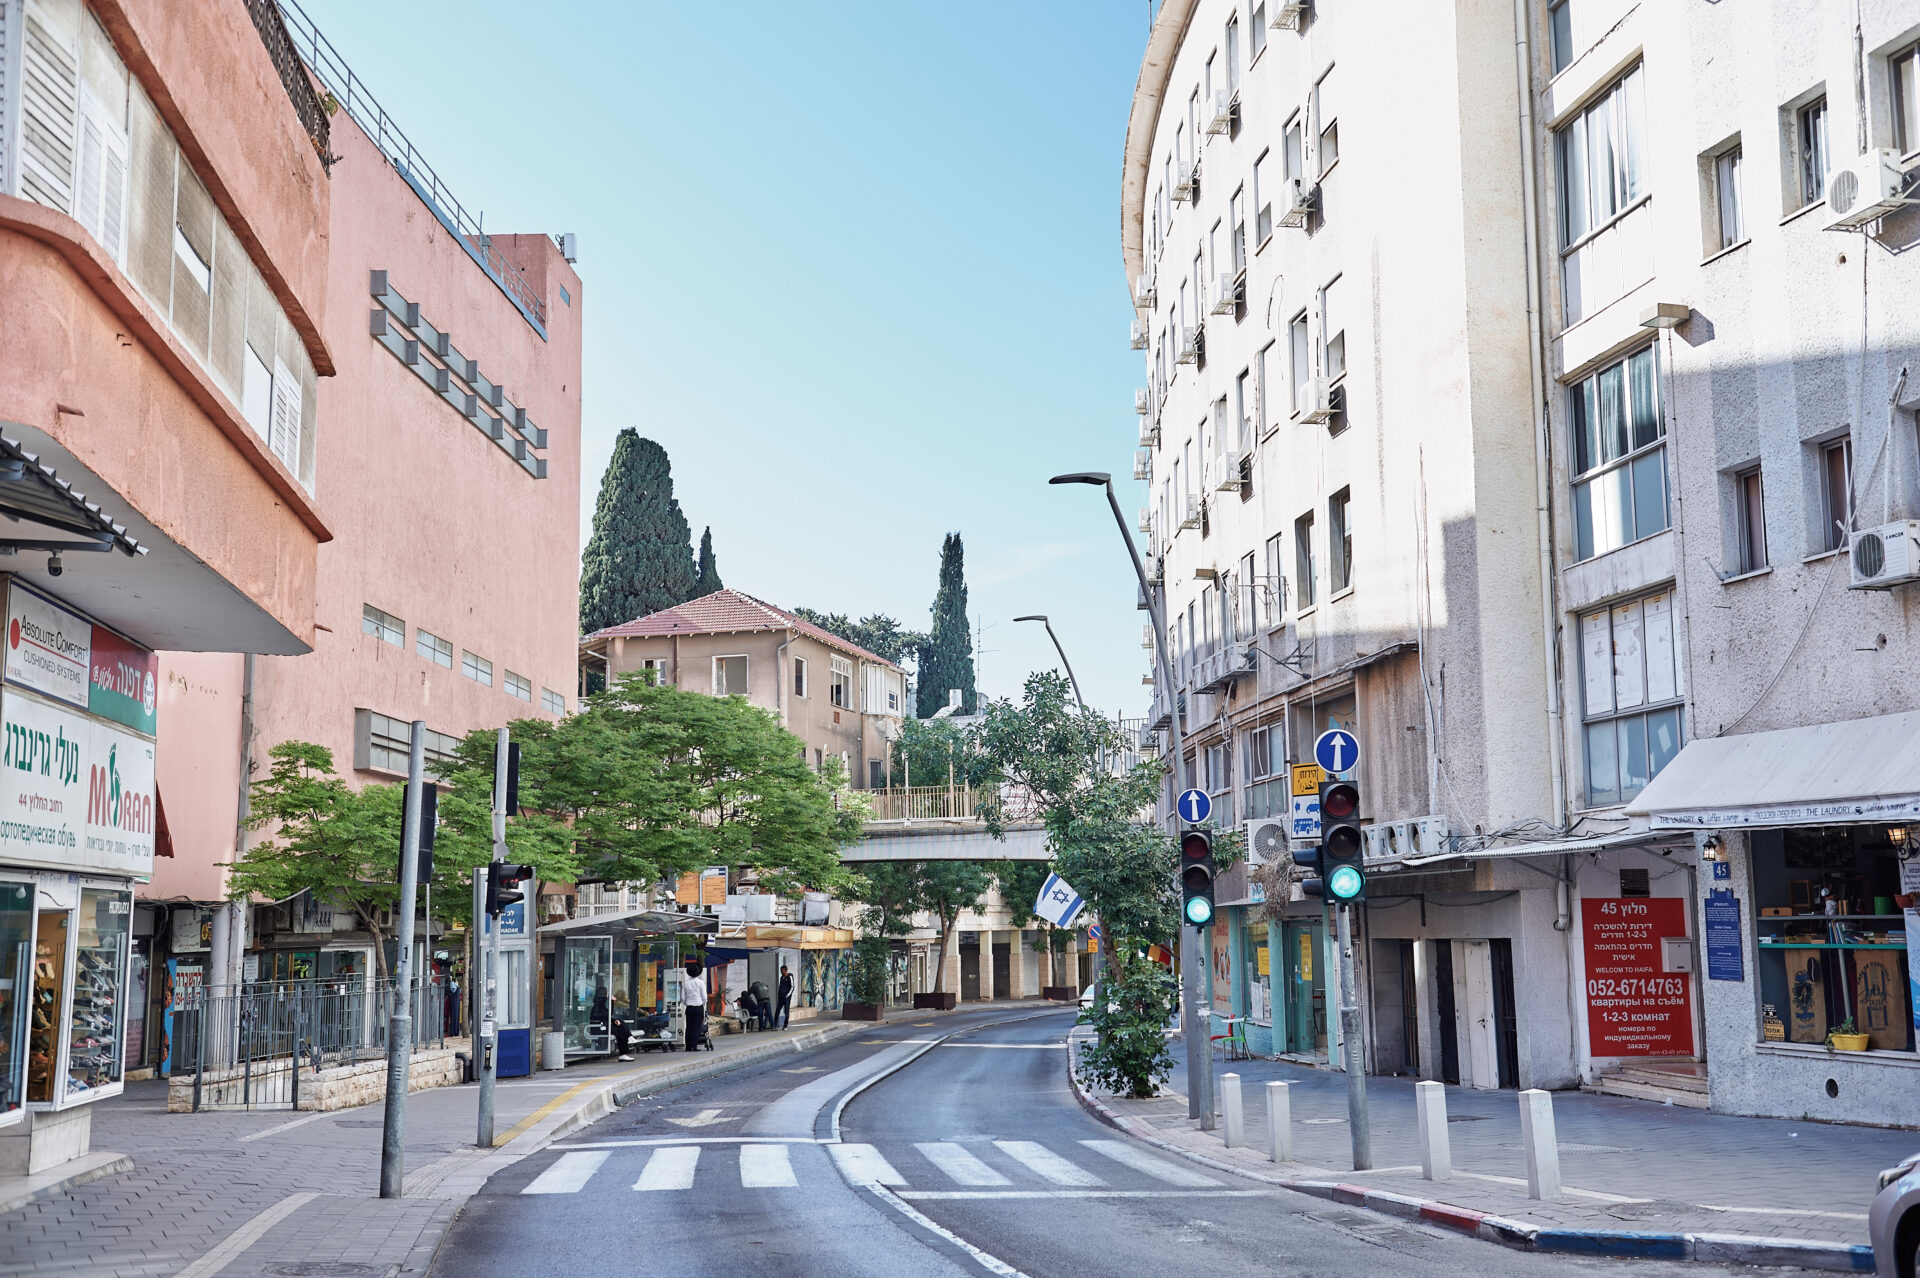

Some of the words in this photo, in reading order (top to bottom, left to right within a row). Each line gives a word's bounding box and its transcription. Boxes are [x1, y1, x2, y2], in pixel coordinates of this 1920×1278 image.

[23, 650, 56, 674] CUSHIONED
[56, 664, 81, 684] SYSTEMS
[117, 661, 142, 701] דפנה
[4, 721, 51, 777] גרינברג
[55, 725, 79, 787] נעלי
[18, 793, 27, 808] 44
[29, 792, 48, 813] החלוץ
[49, 799, 63, 814] רחוב
[1866, 803, 1885, 812] Coffee
[1806, 807, 1818, 817] THE
[1821, 806, 1850, 816] LAUNDRY
[0, 820, 56, 847] ортопедическая
[57, 822, 77, 854] обувь
[1716, 862, 1727, 876] 45
[1601, 902, 1617, 914] 45
[1593, 922, 1628, 930] להשכרה
[1588, 978, 1683, 996] 052-6714763
[1591, 998, 1640, 1008] квартиры
[1643, 998, 1655, 1006] на
[1657, 996, 1684, 1005] съём
[1602, 1012, 1629, 1022] 1-2-3
[1631, 1013, 1670, 1022] комнат
